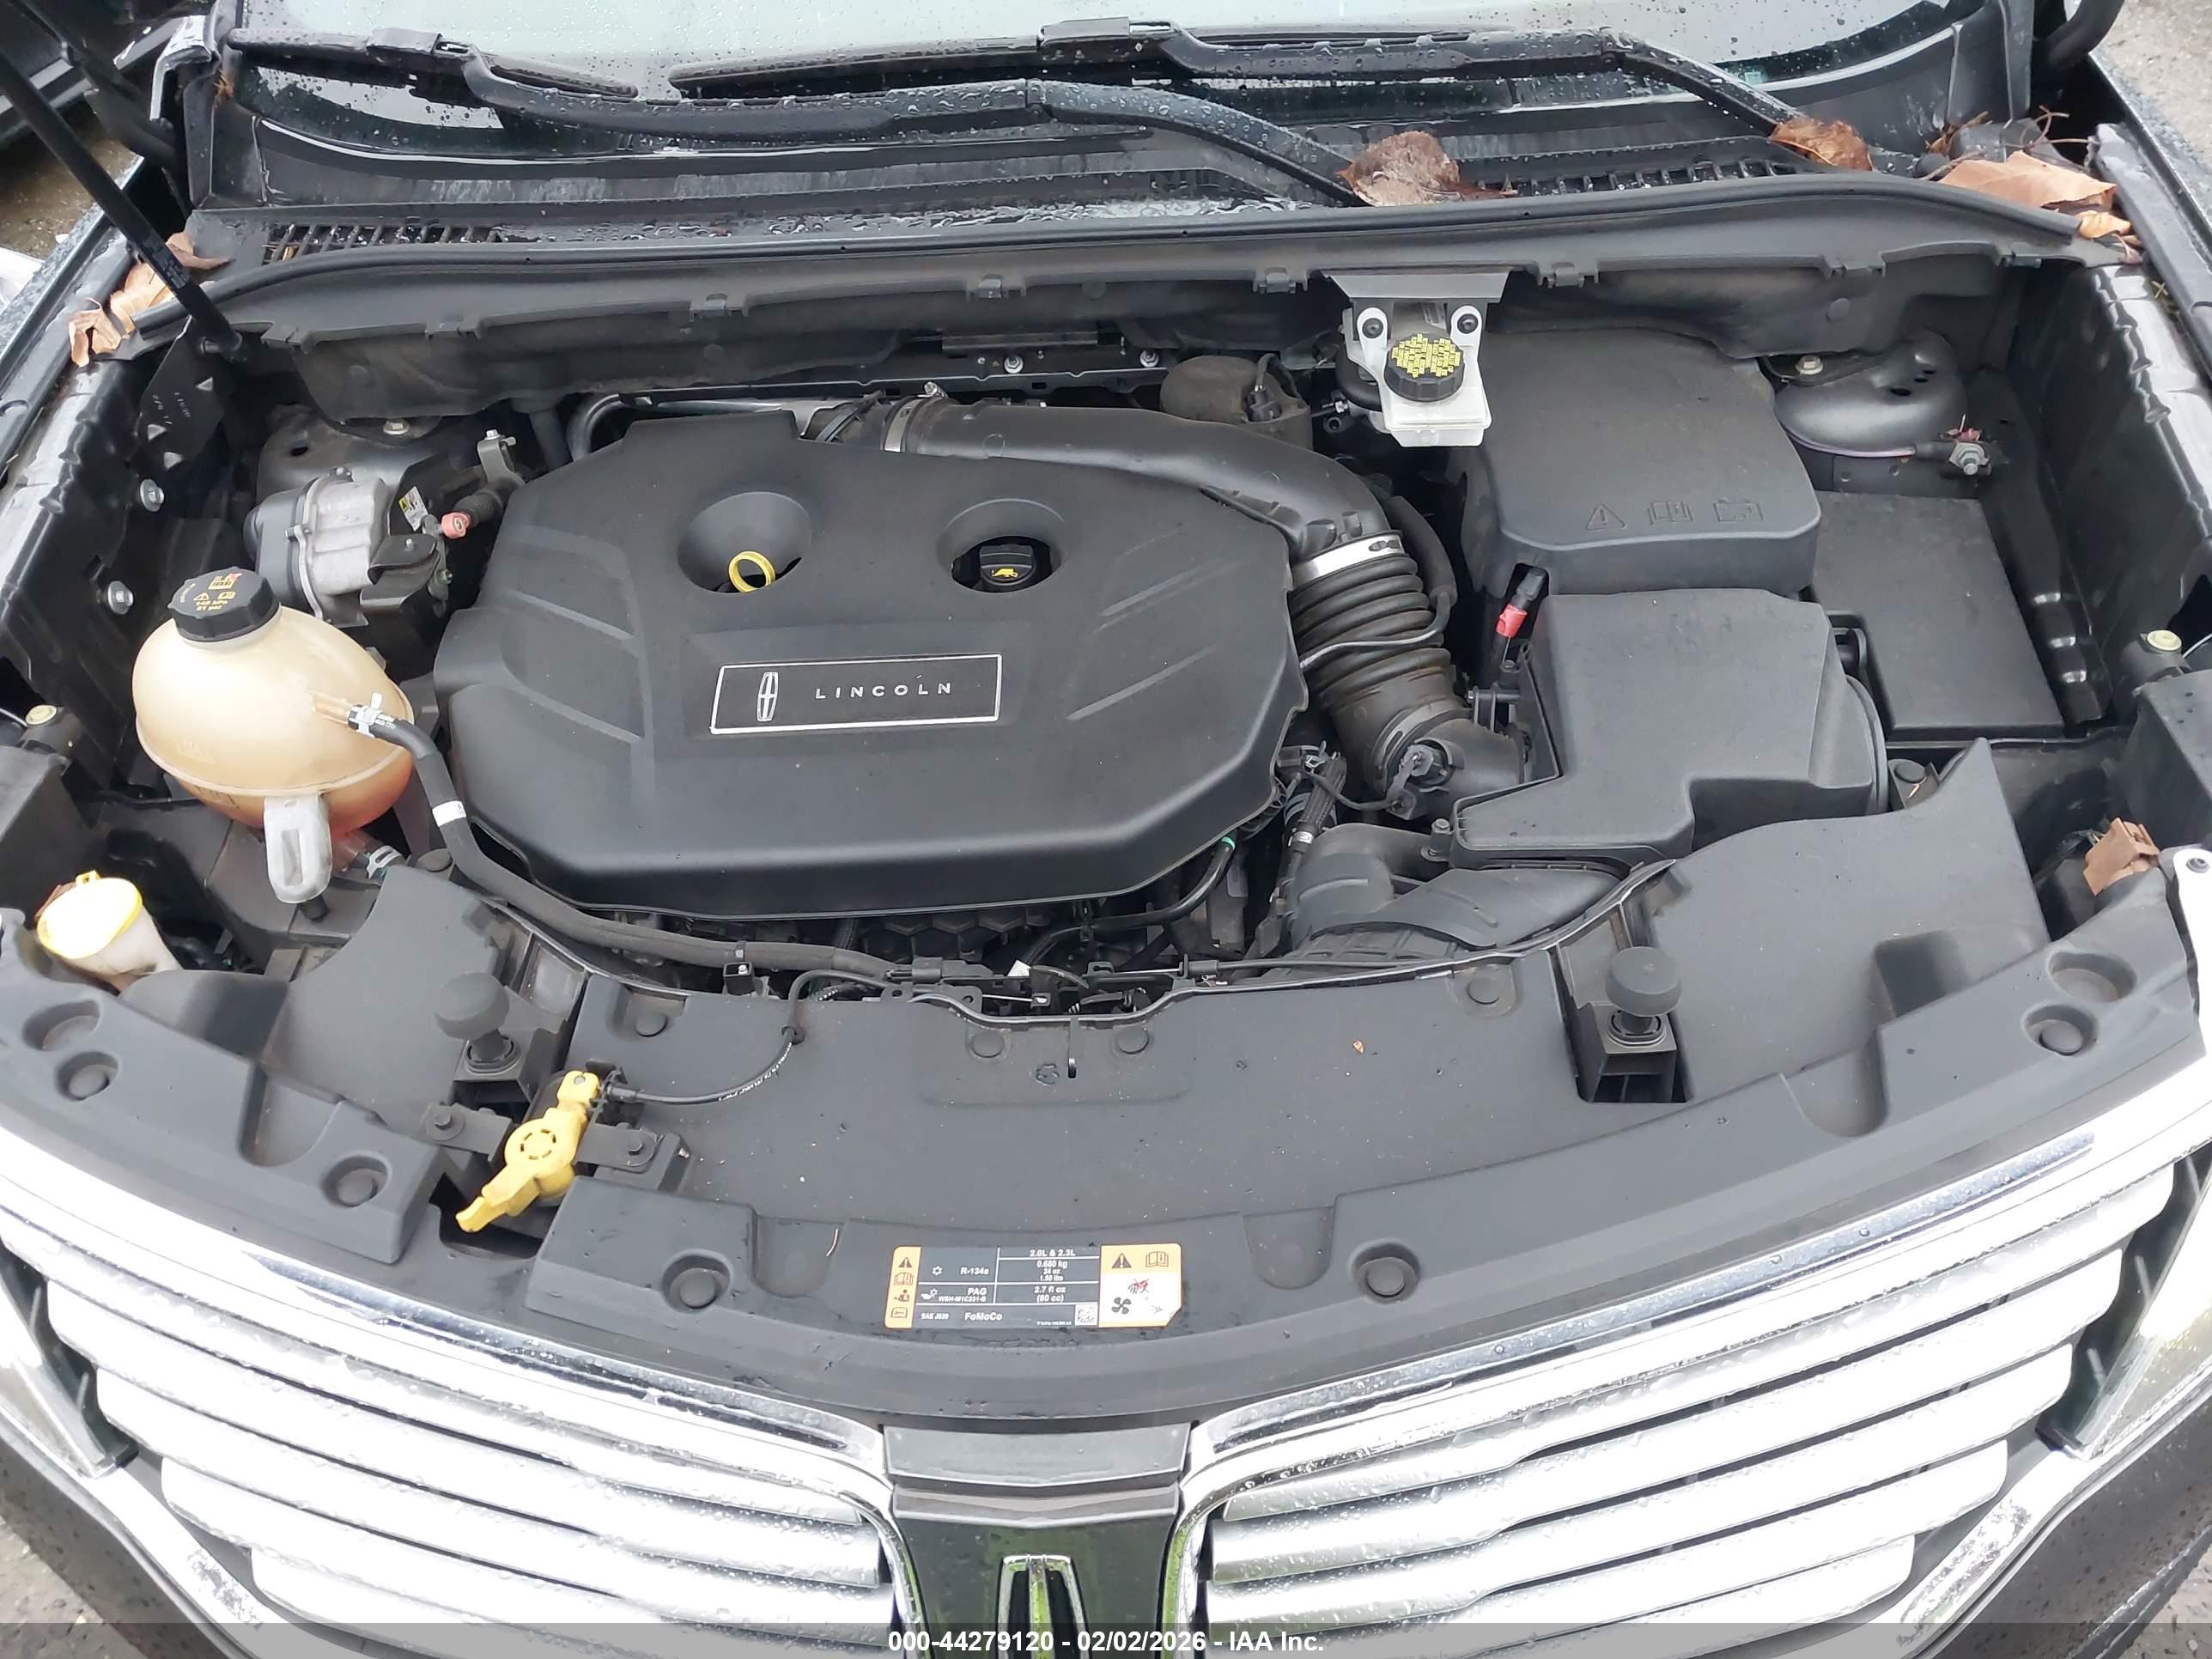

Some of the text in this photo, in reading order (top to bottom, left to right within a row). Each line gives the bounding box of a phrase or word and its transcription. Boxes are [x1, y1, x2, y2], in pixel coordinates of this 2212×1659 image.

[815, 684, 951, 699] LINCOLN
[1058, 1260, 1068, 1269] kg
[959, 1267, 990, 1275] R-134a
[964, 1312, 1003, 1321] FoMoCo
